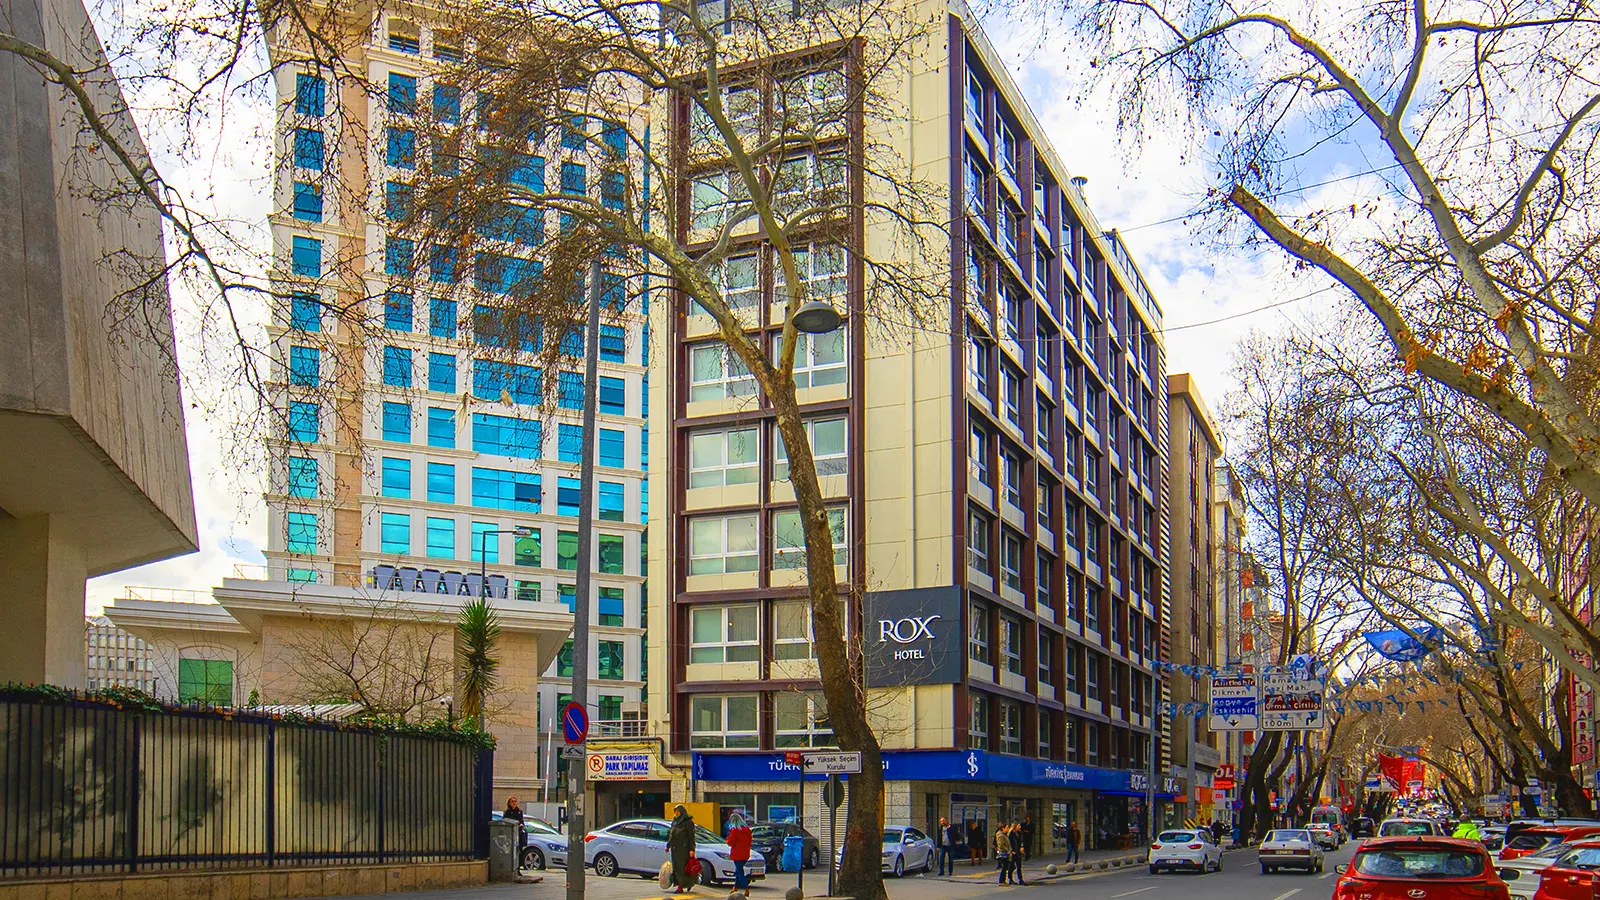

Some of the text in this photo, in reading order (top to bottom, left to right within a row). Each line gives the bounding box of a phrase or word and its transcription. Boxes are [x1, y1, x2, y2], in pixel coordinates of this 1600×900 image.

[878, 615, 941, 643] ROX
[894, 649, 925, 660] HOTEL
[816, 755, 857, 763] Yüksek Seçim
[605, 762, 648, 771] PARK YAPILMAZ
